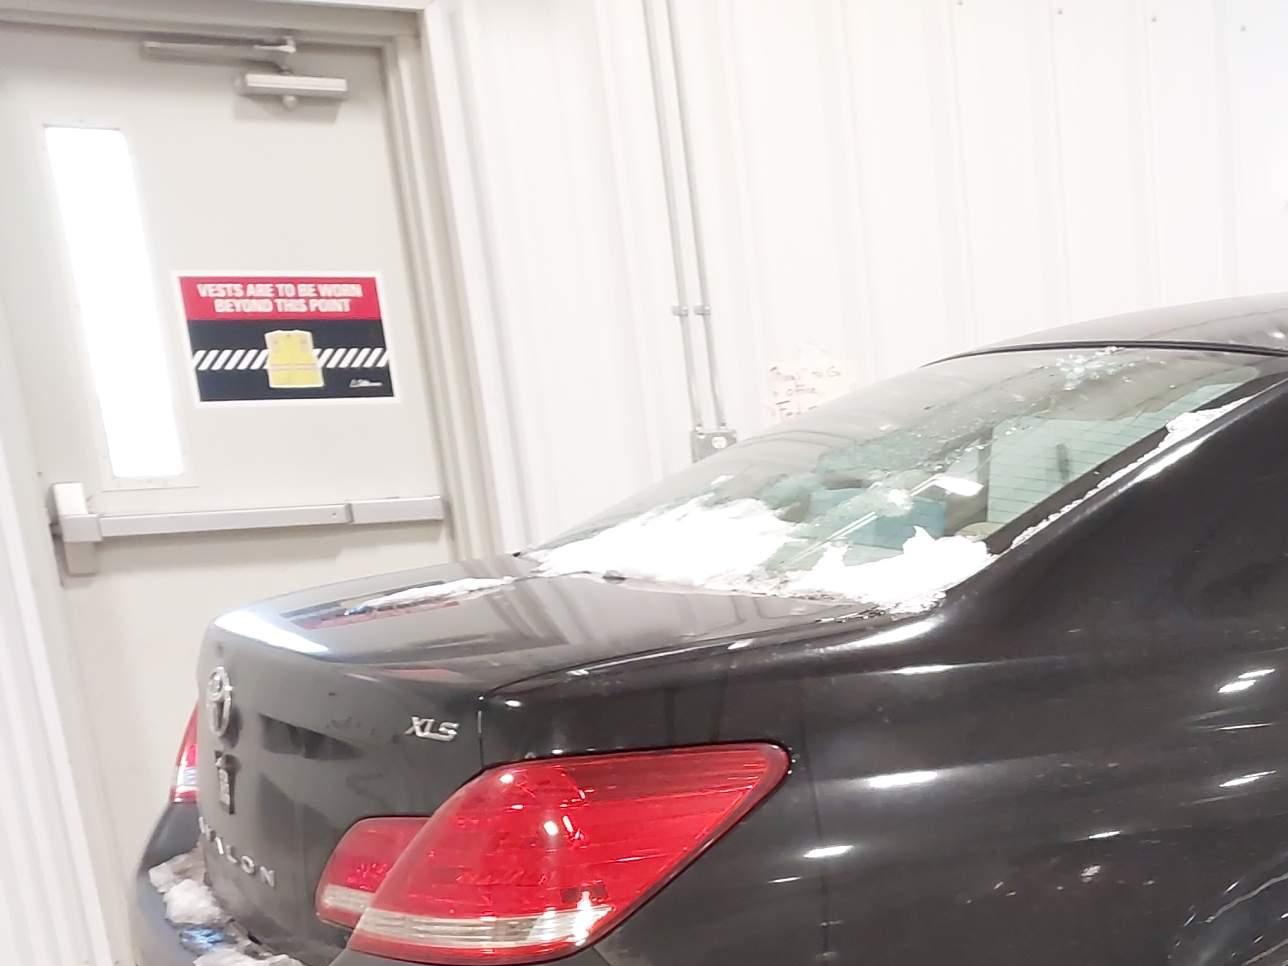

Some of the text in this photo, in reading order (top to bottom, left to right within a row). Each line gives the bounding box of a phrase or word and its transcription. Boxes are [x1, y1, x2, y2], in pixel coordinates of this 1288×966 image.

[196, 283, 363, 298] VESTS ARE TO BE WORN
[214, 298, 351, 313] BEYOND THIS POINT
[403, 716, 460, 742] XLS
